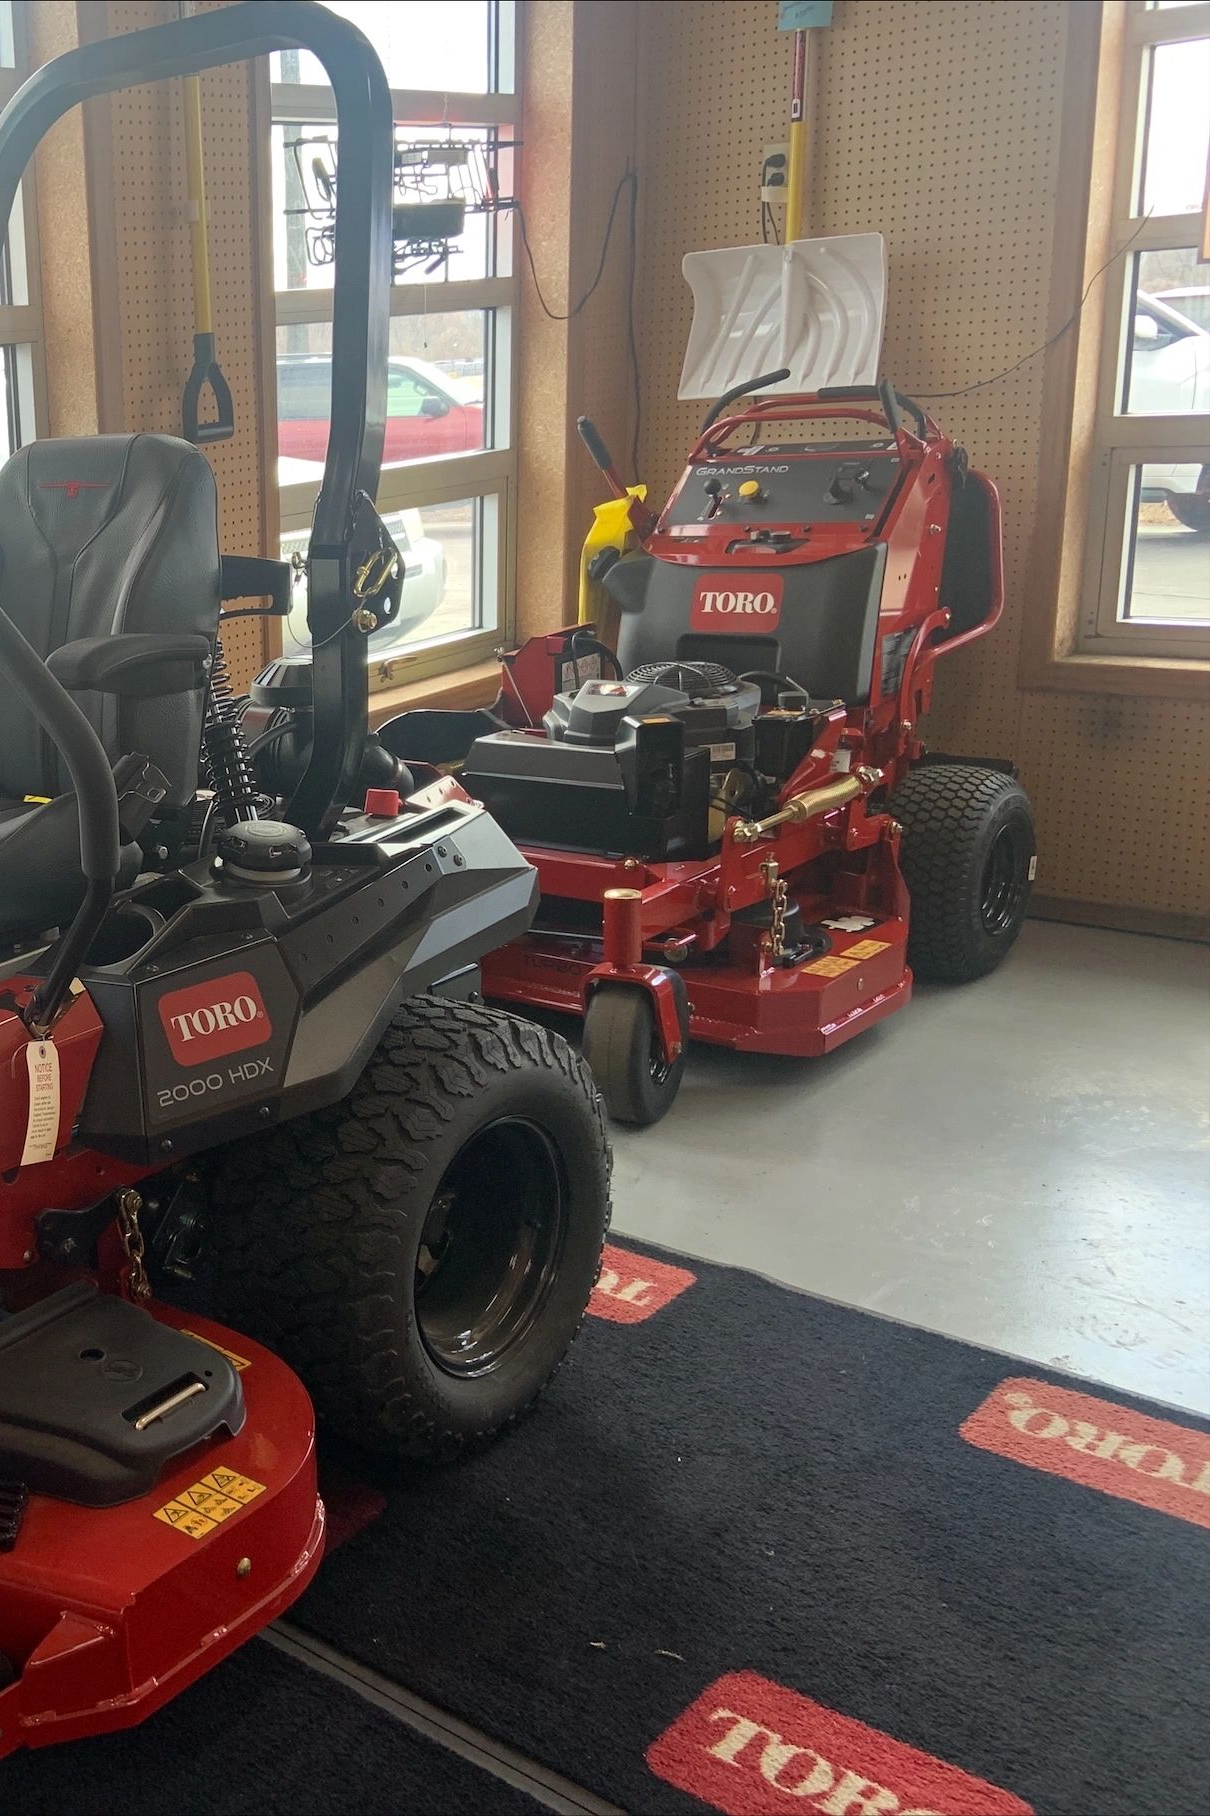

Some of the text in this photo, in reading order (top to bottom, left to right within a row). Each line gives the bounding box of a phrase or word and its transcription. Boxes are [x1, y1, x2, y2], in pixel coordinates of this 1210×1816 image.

[699, 591, 774, 614] TORO
[170, 995, 257, 1042] TORO
[34, 1063, 53, 1073] NOTICE
[36, 1073, 52, 1083] BEFORE
[35, 1083, 54, 1092] STARTING
[157, 1056, 275, 1107] 2000 HDX
[707, 1707, 948, 1816] TOR
